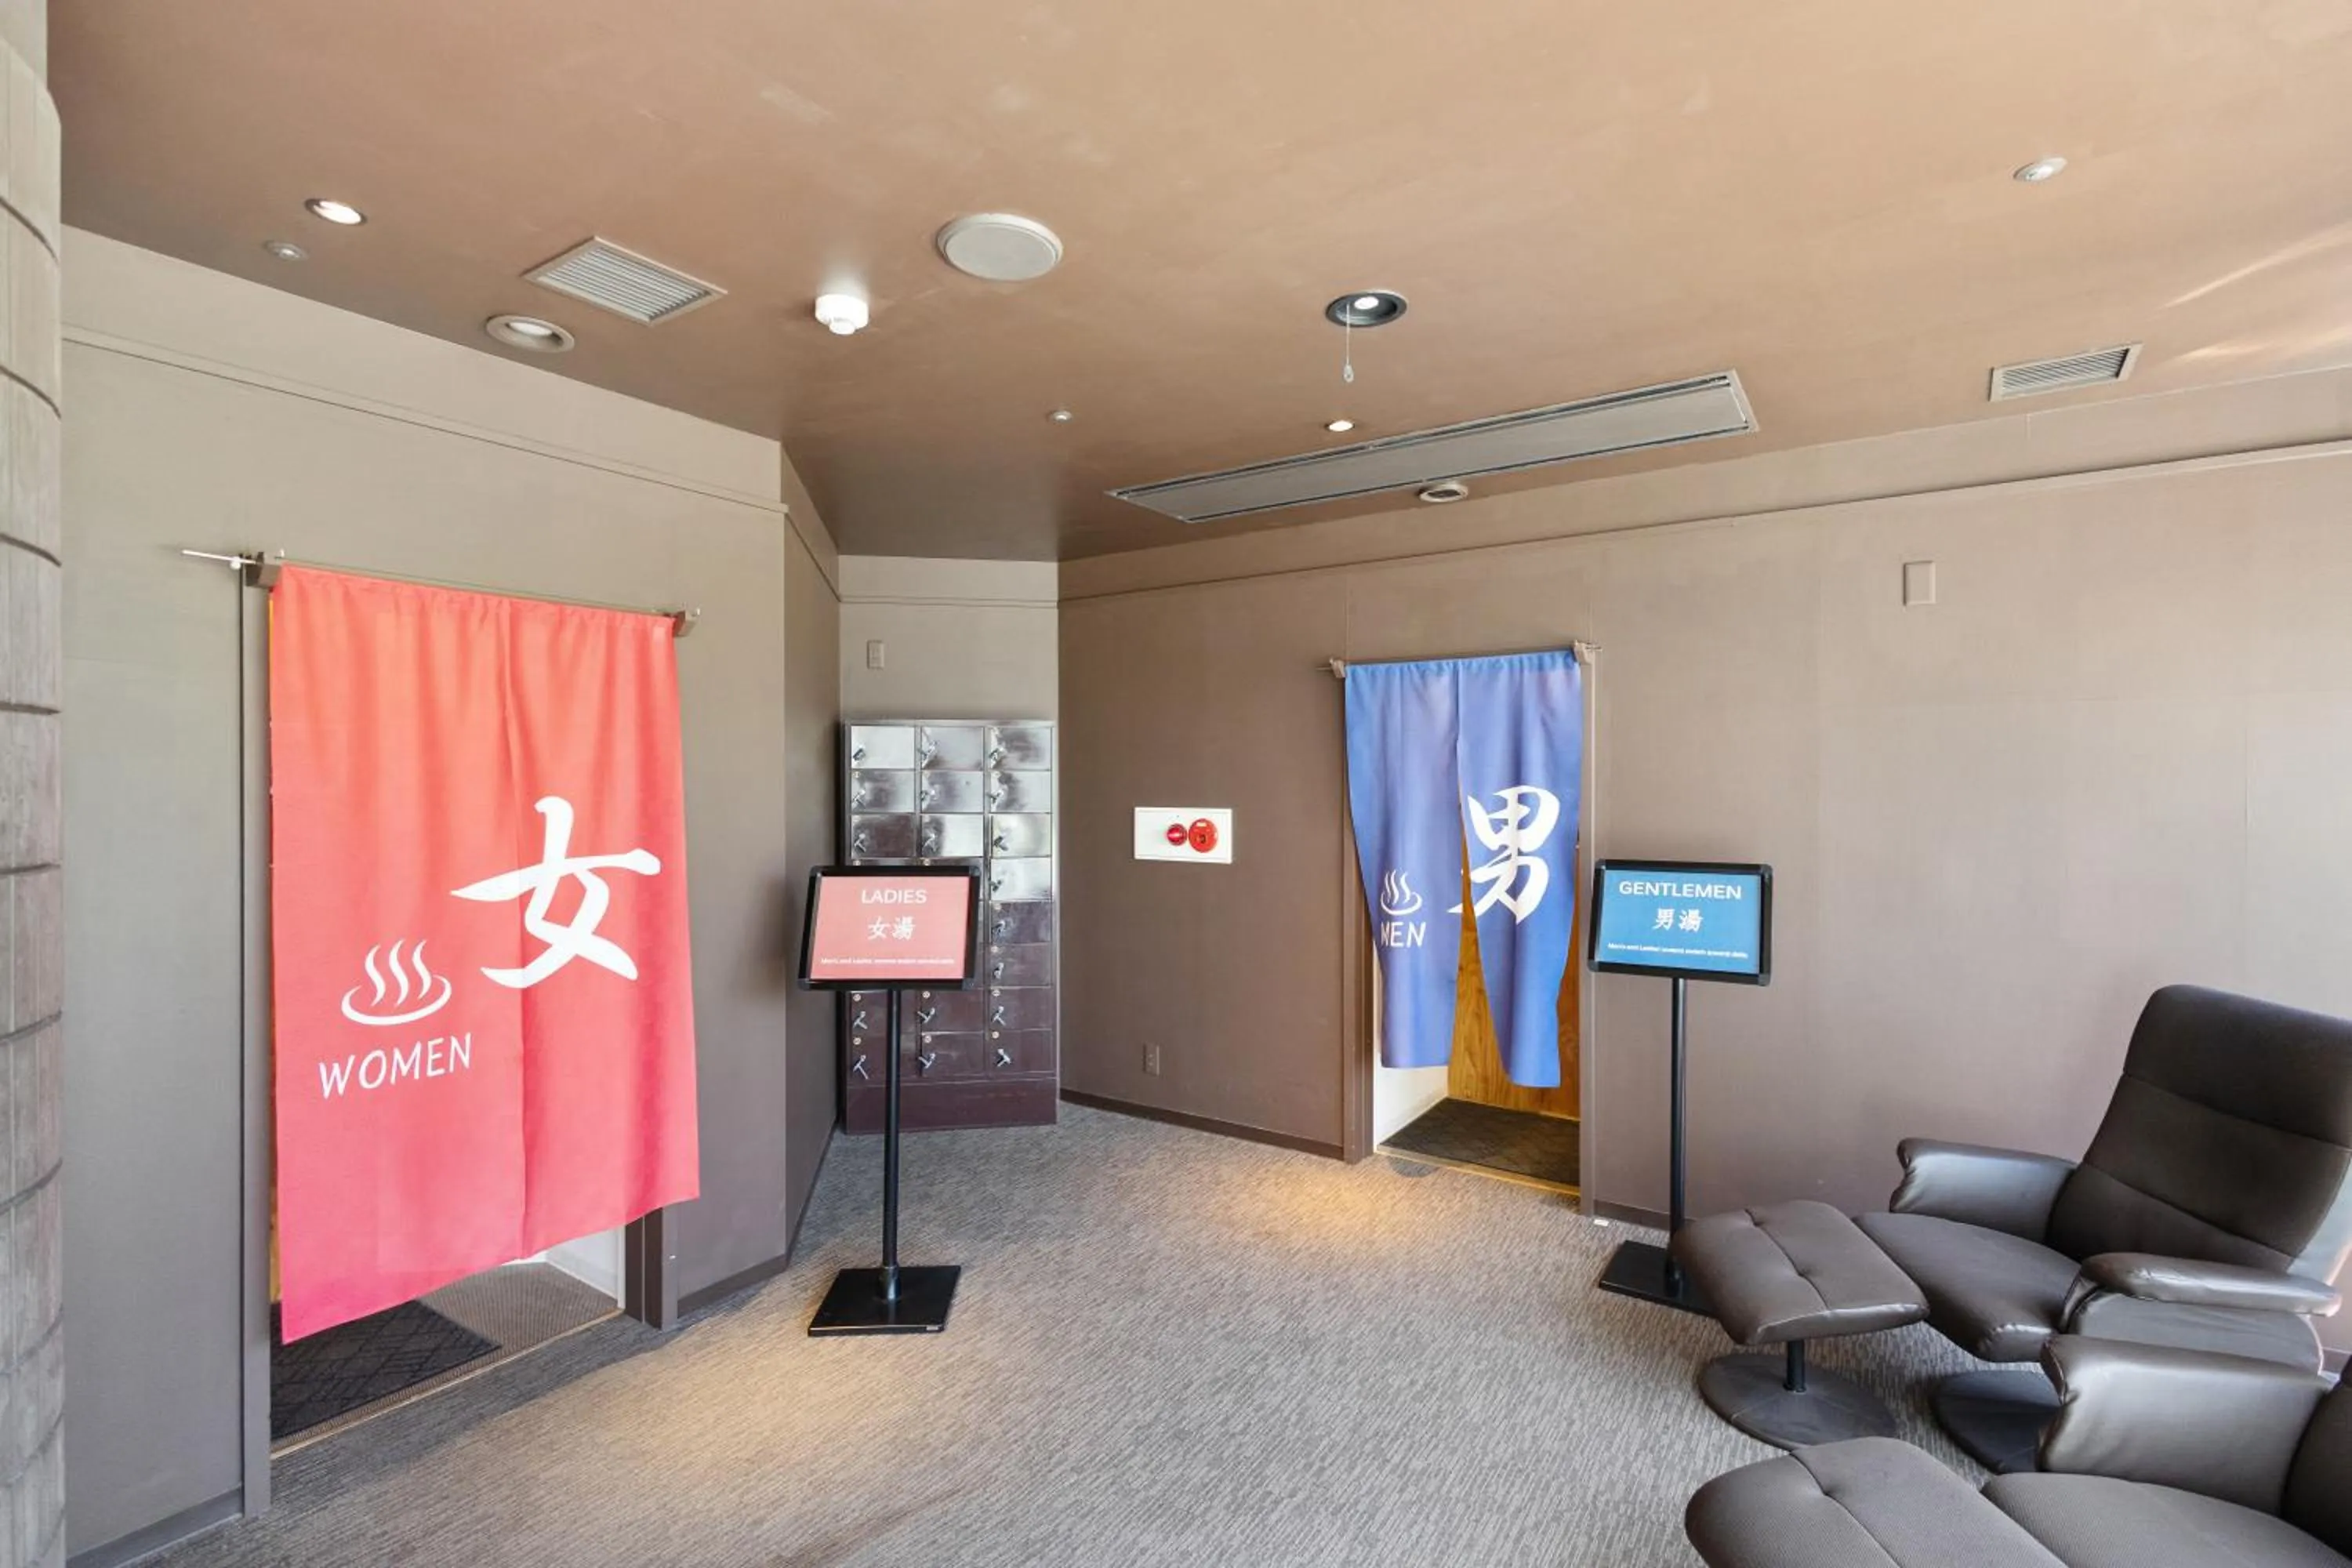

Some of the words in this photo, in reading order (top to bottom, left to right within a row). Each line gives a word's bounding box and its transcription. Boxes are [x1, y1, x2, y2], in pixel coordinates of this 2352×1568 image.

[1447, 785, 1559, 925] 男
[450, 796, 662, 989] 女
[861, 889, 927, 904] LADIES
[1619, 880, 1742, 900] GENTLEMEN
[318, 1033, 472, 1099] WOMEN
